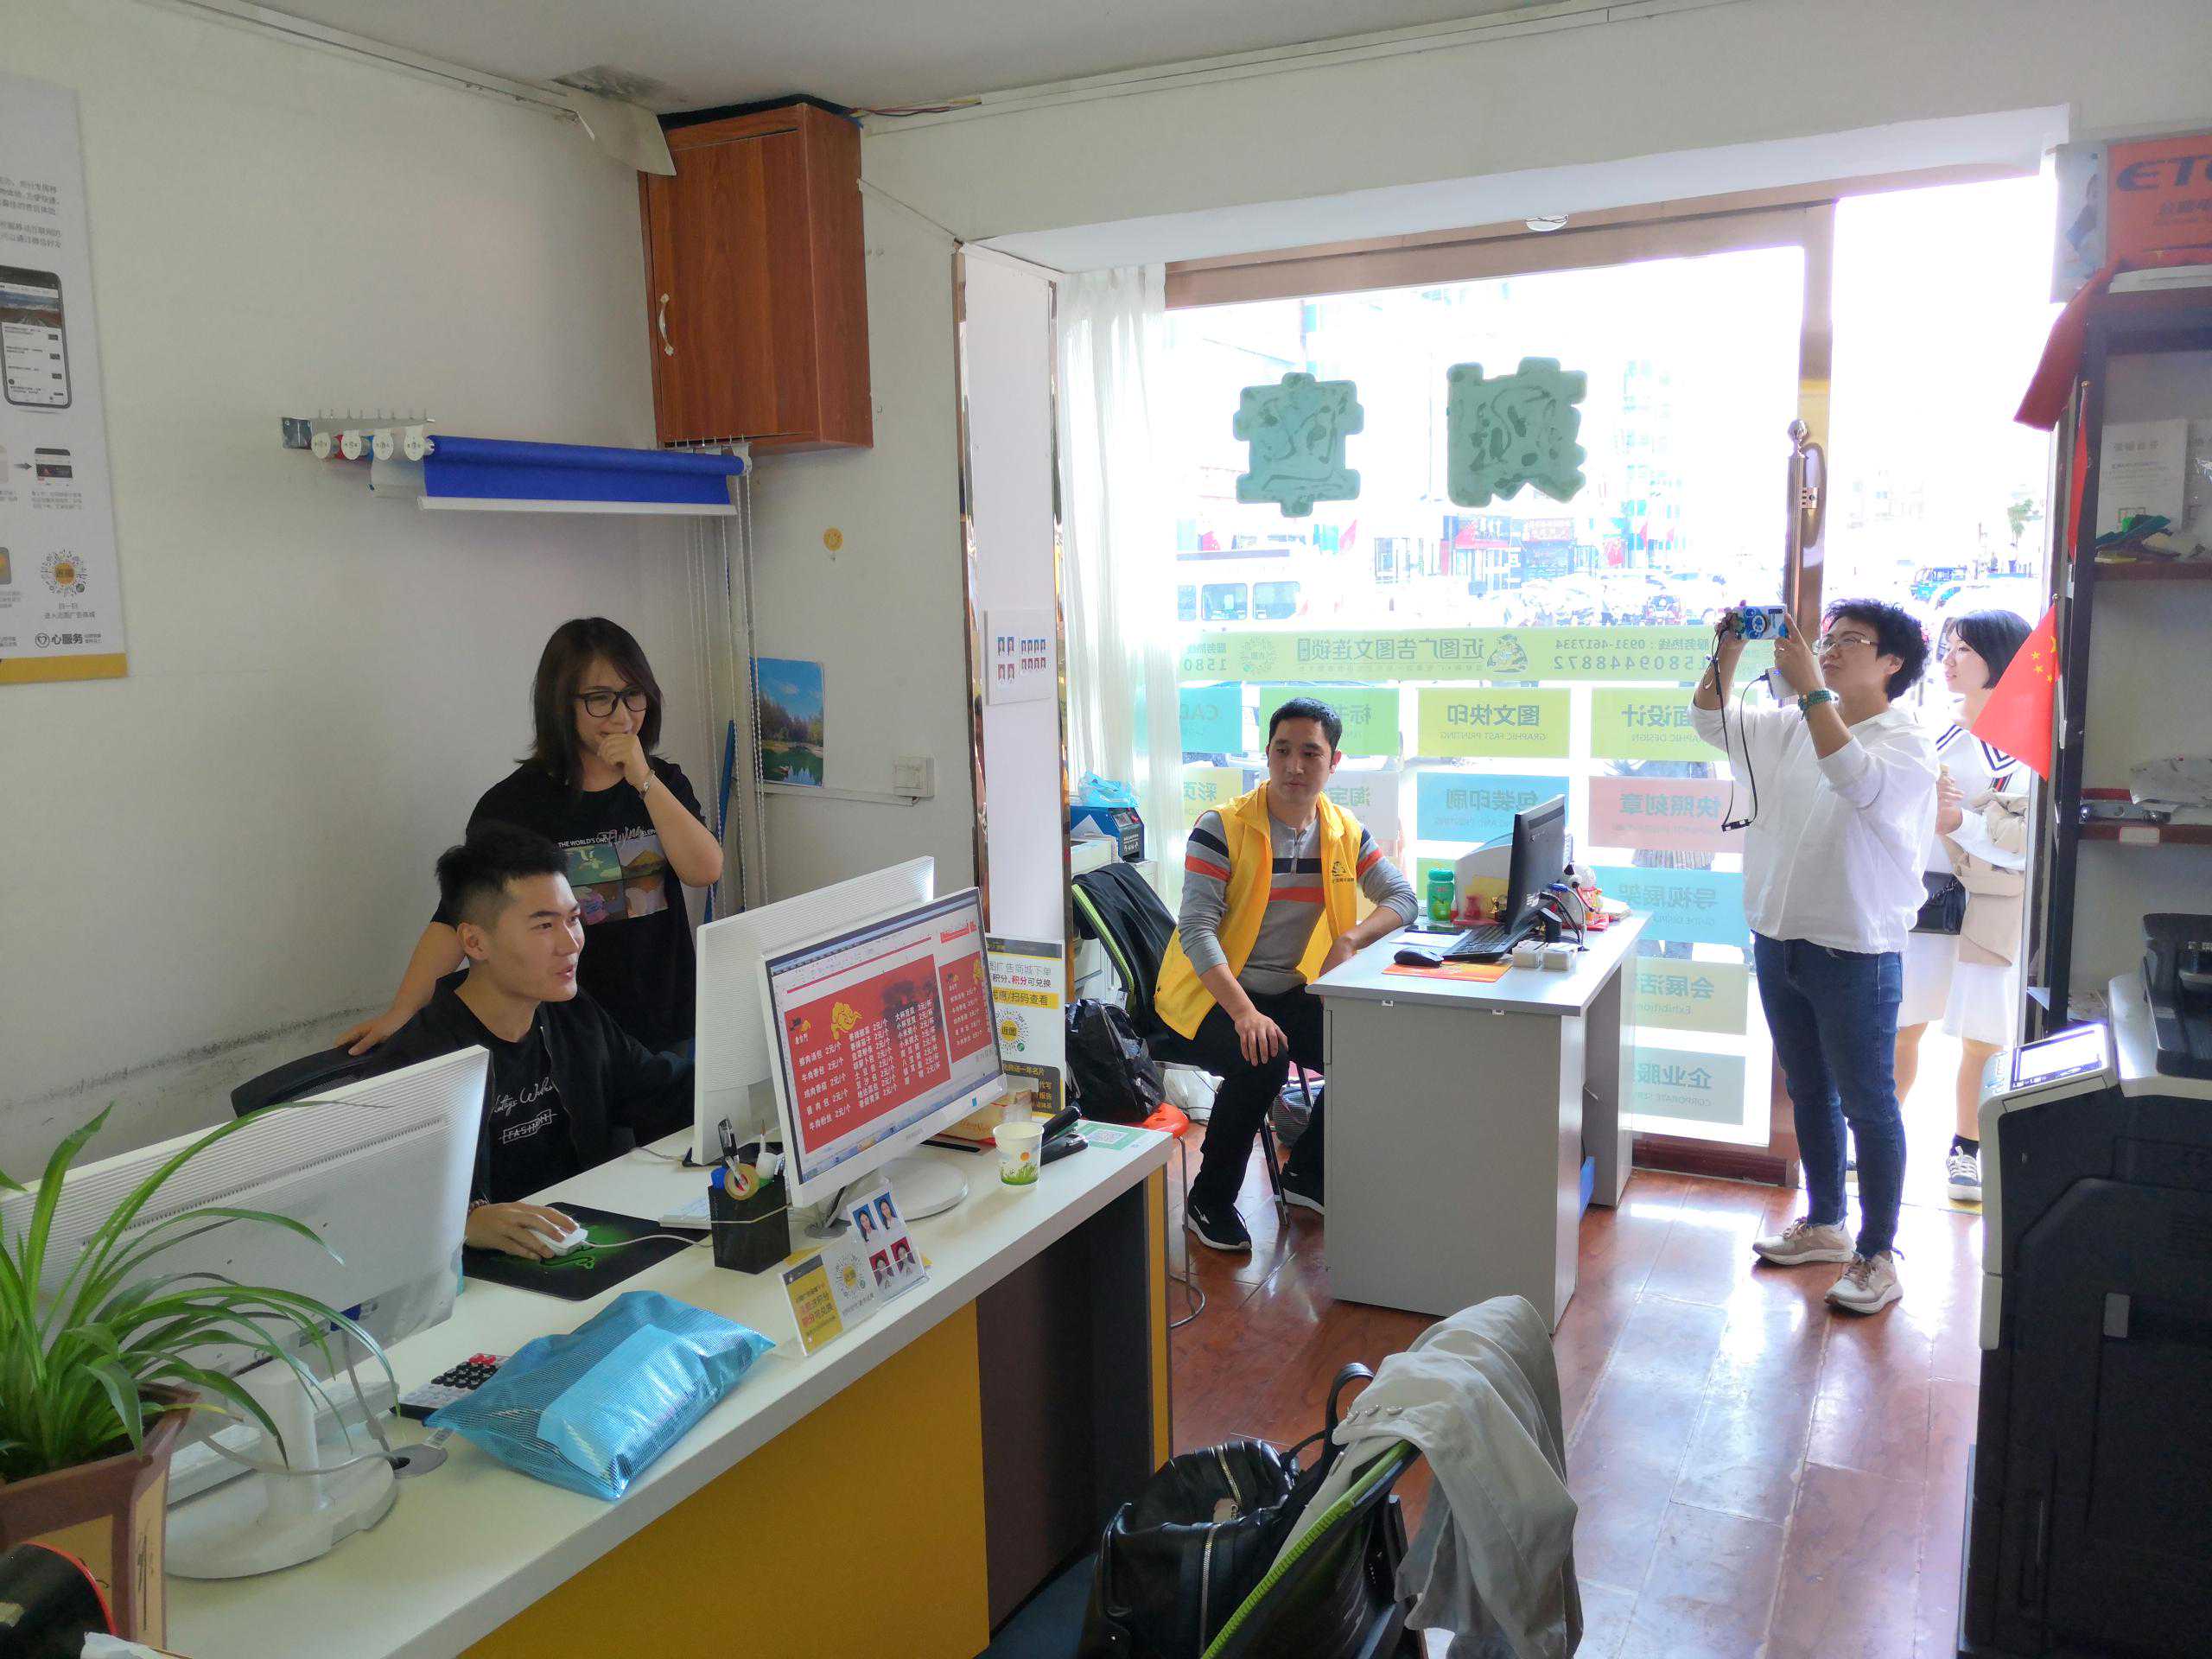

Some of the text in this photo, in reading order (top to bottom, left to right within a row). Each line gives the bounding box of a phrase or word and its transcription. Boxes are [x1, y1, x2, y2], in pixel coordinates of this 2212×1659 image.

[2116, 154, 2212, 192] ET
[52, 633, 83, 645] 心服务
[557, 840, 571, 849] THE
